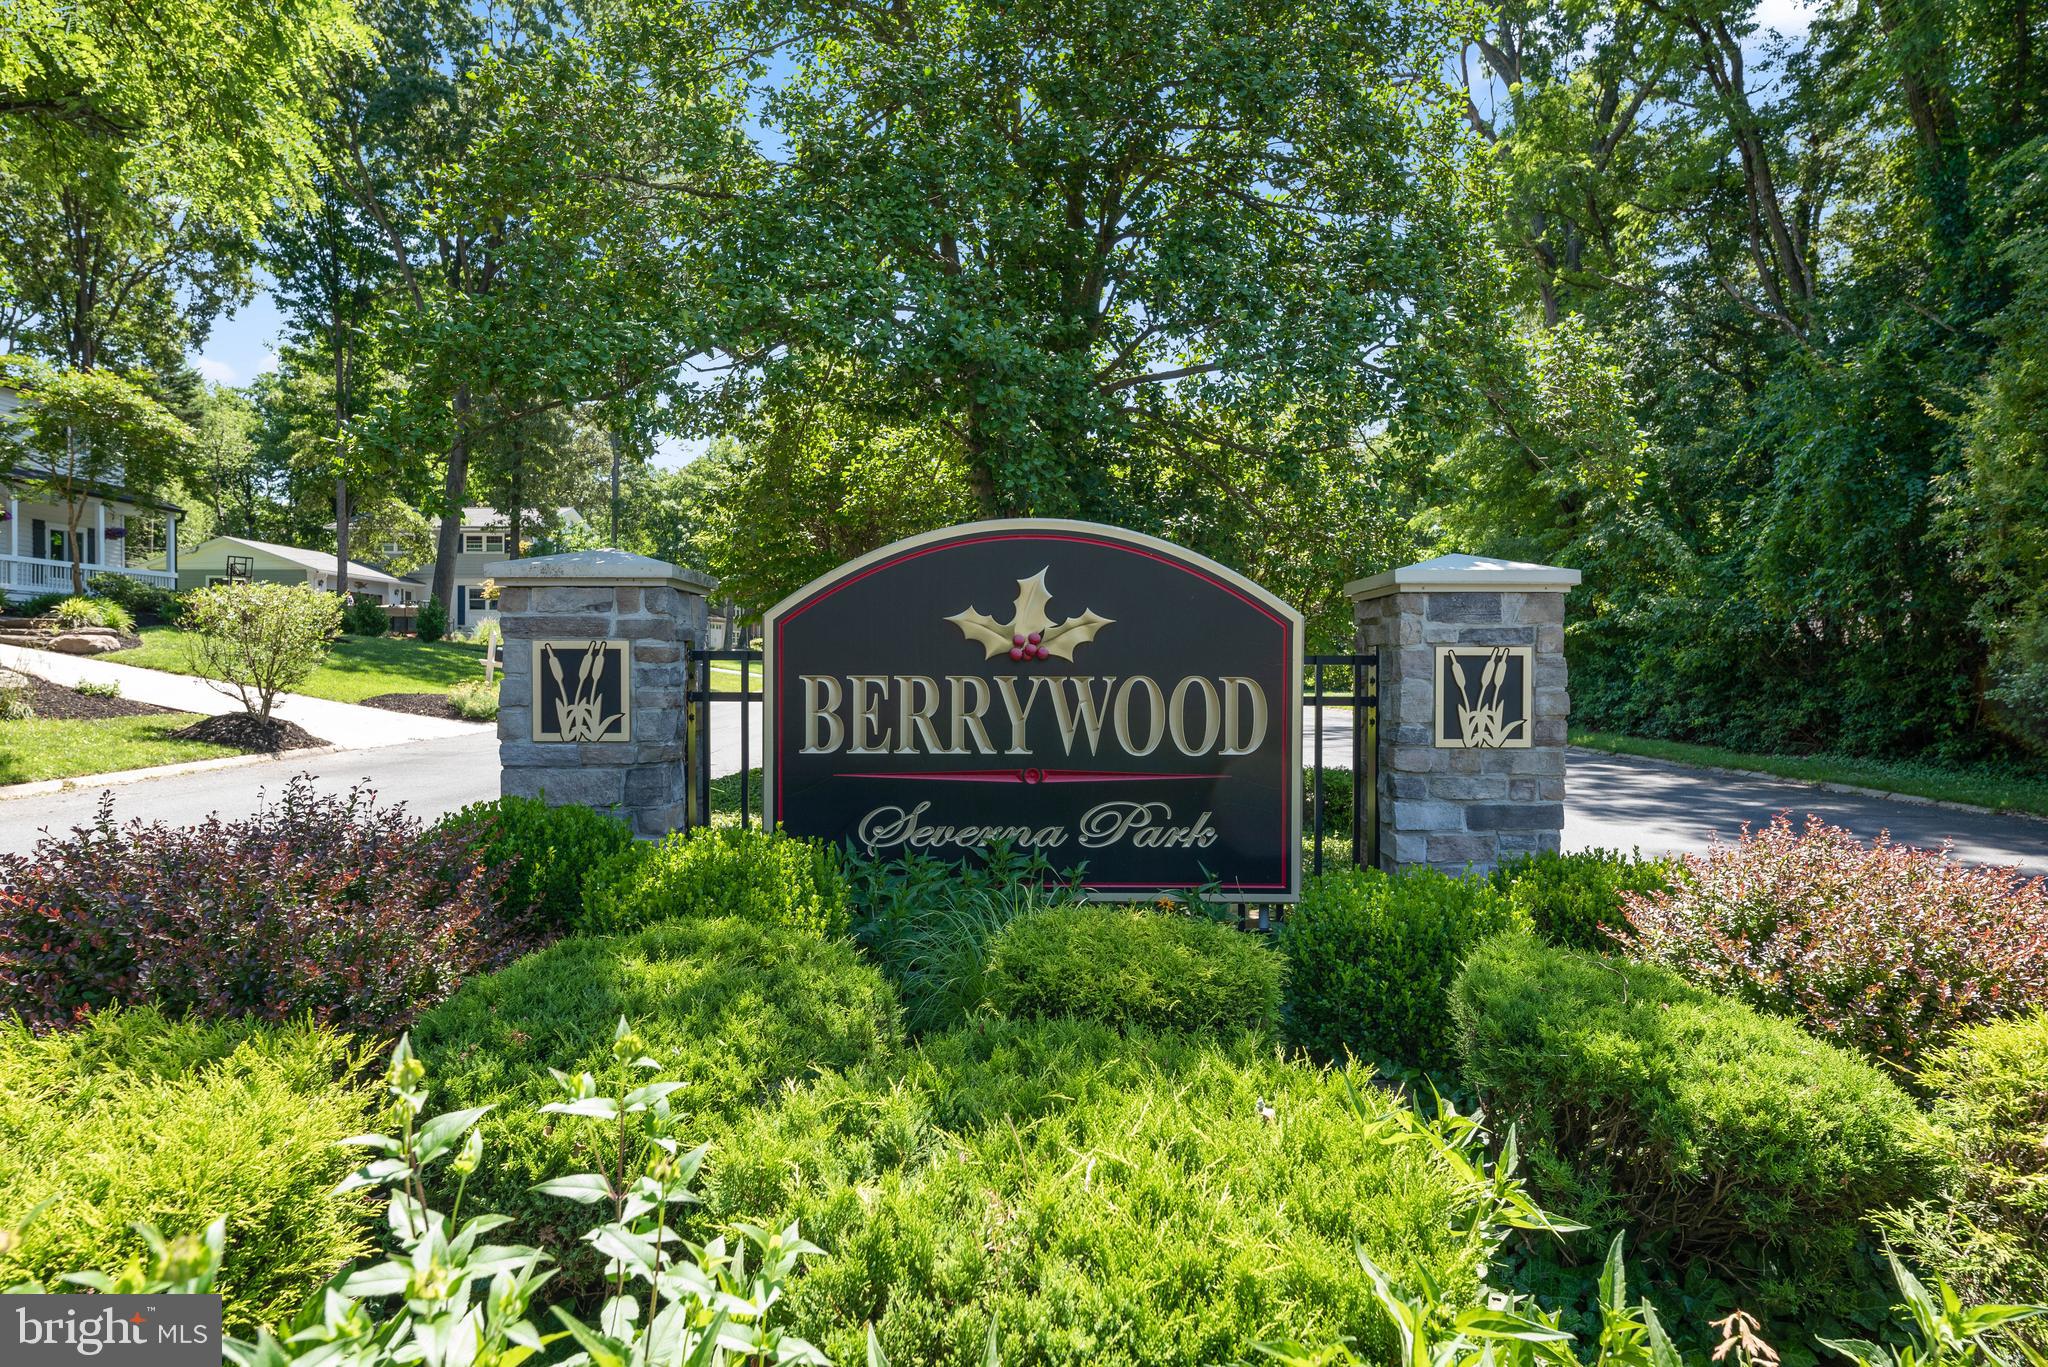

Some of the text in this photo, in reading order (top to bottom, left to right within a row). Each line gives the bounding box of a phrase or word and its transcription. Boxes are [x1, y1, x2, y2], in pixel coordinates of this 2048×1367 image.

[799, 674, 1268, 758] BERRYWOOD
[857, 800, 1218, 857] Severna Park
